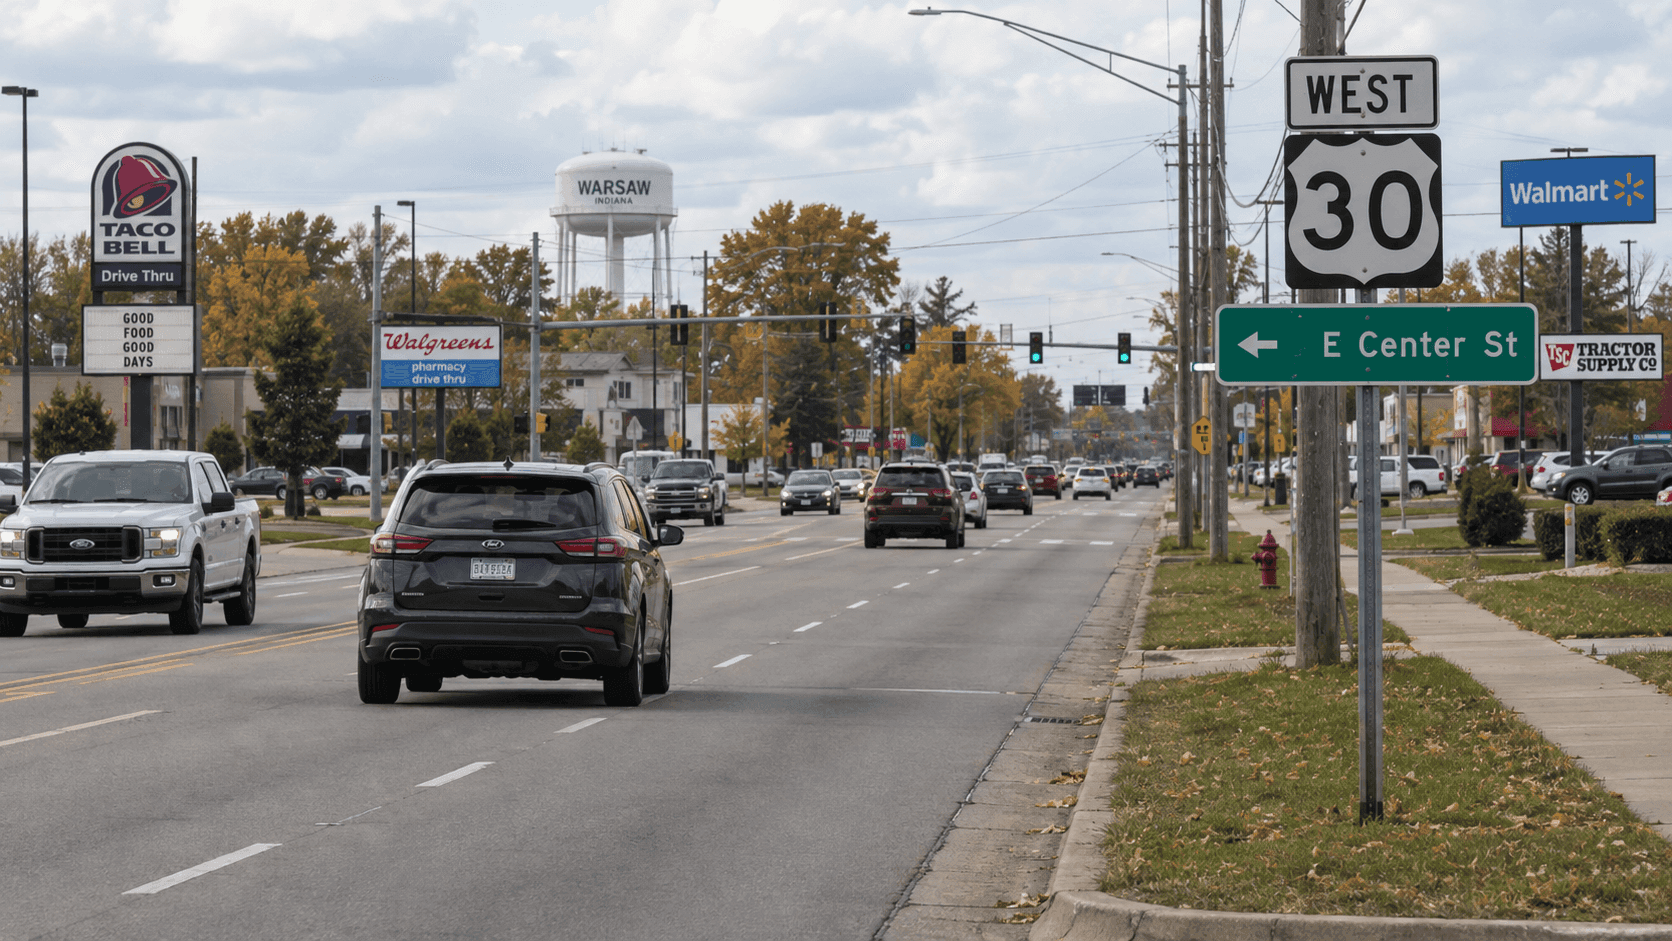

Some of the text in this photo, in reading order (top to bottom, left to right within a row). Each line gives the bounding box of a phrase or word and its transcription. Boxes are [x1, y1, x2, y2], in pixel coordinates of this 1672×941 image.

[1306, 74, 1413, 114] WEST
[578, 180, 651, 195] WARSAW
[1509, 179, 1609, 205] Walmart
[1303, 170, 1423, 250] 30
[100, 223, 176, 237] TACO
[104, 241, 175, 255] BELL
[101, 270, 174, 282] Drive Thru
[123, 313, 154, 323] GOOD
[123, 328, 154, 338] FOOD
[123, 342, 154, 352] GOOD
[383, 332, 494, 356] Walgreens
[1323, 331, 1518, 357] E Center St
[1576, 342, 1657, 356] TRACTOR
[123, 356, 153, 367] DAYS
[1548, 344, 1569, 366] TSC
[411, 361, 467, 373] pharmacy
[1577, 358, 1636, 371] SUPPLY
[412, 374, 466, 384] drive thru
